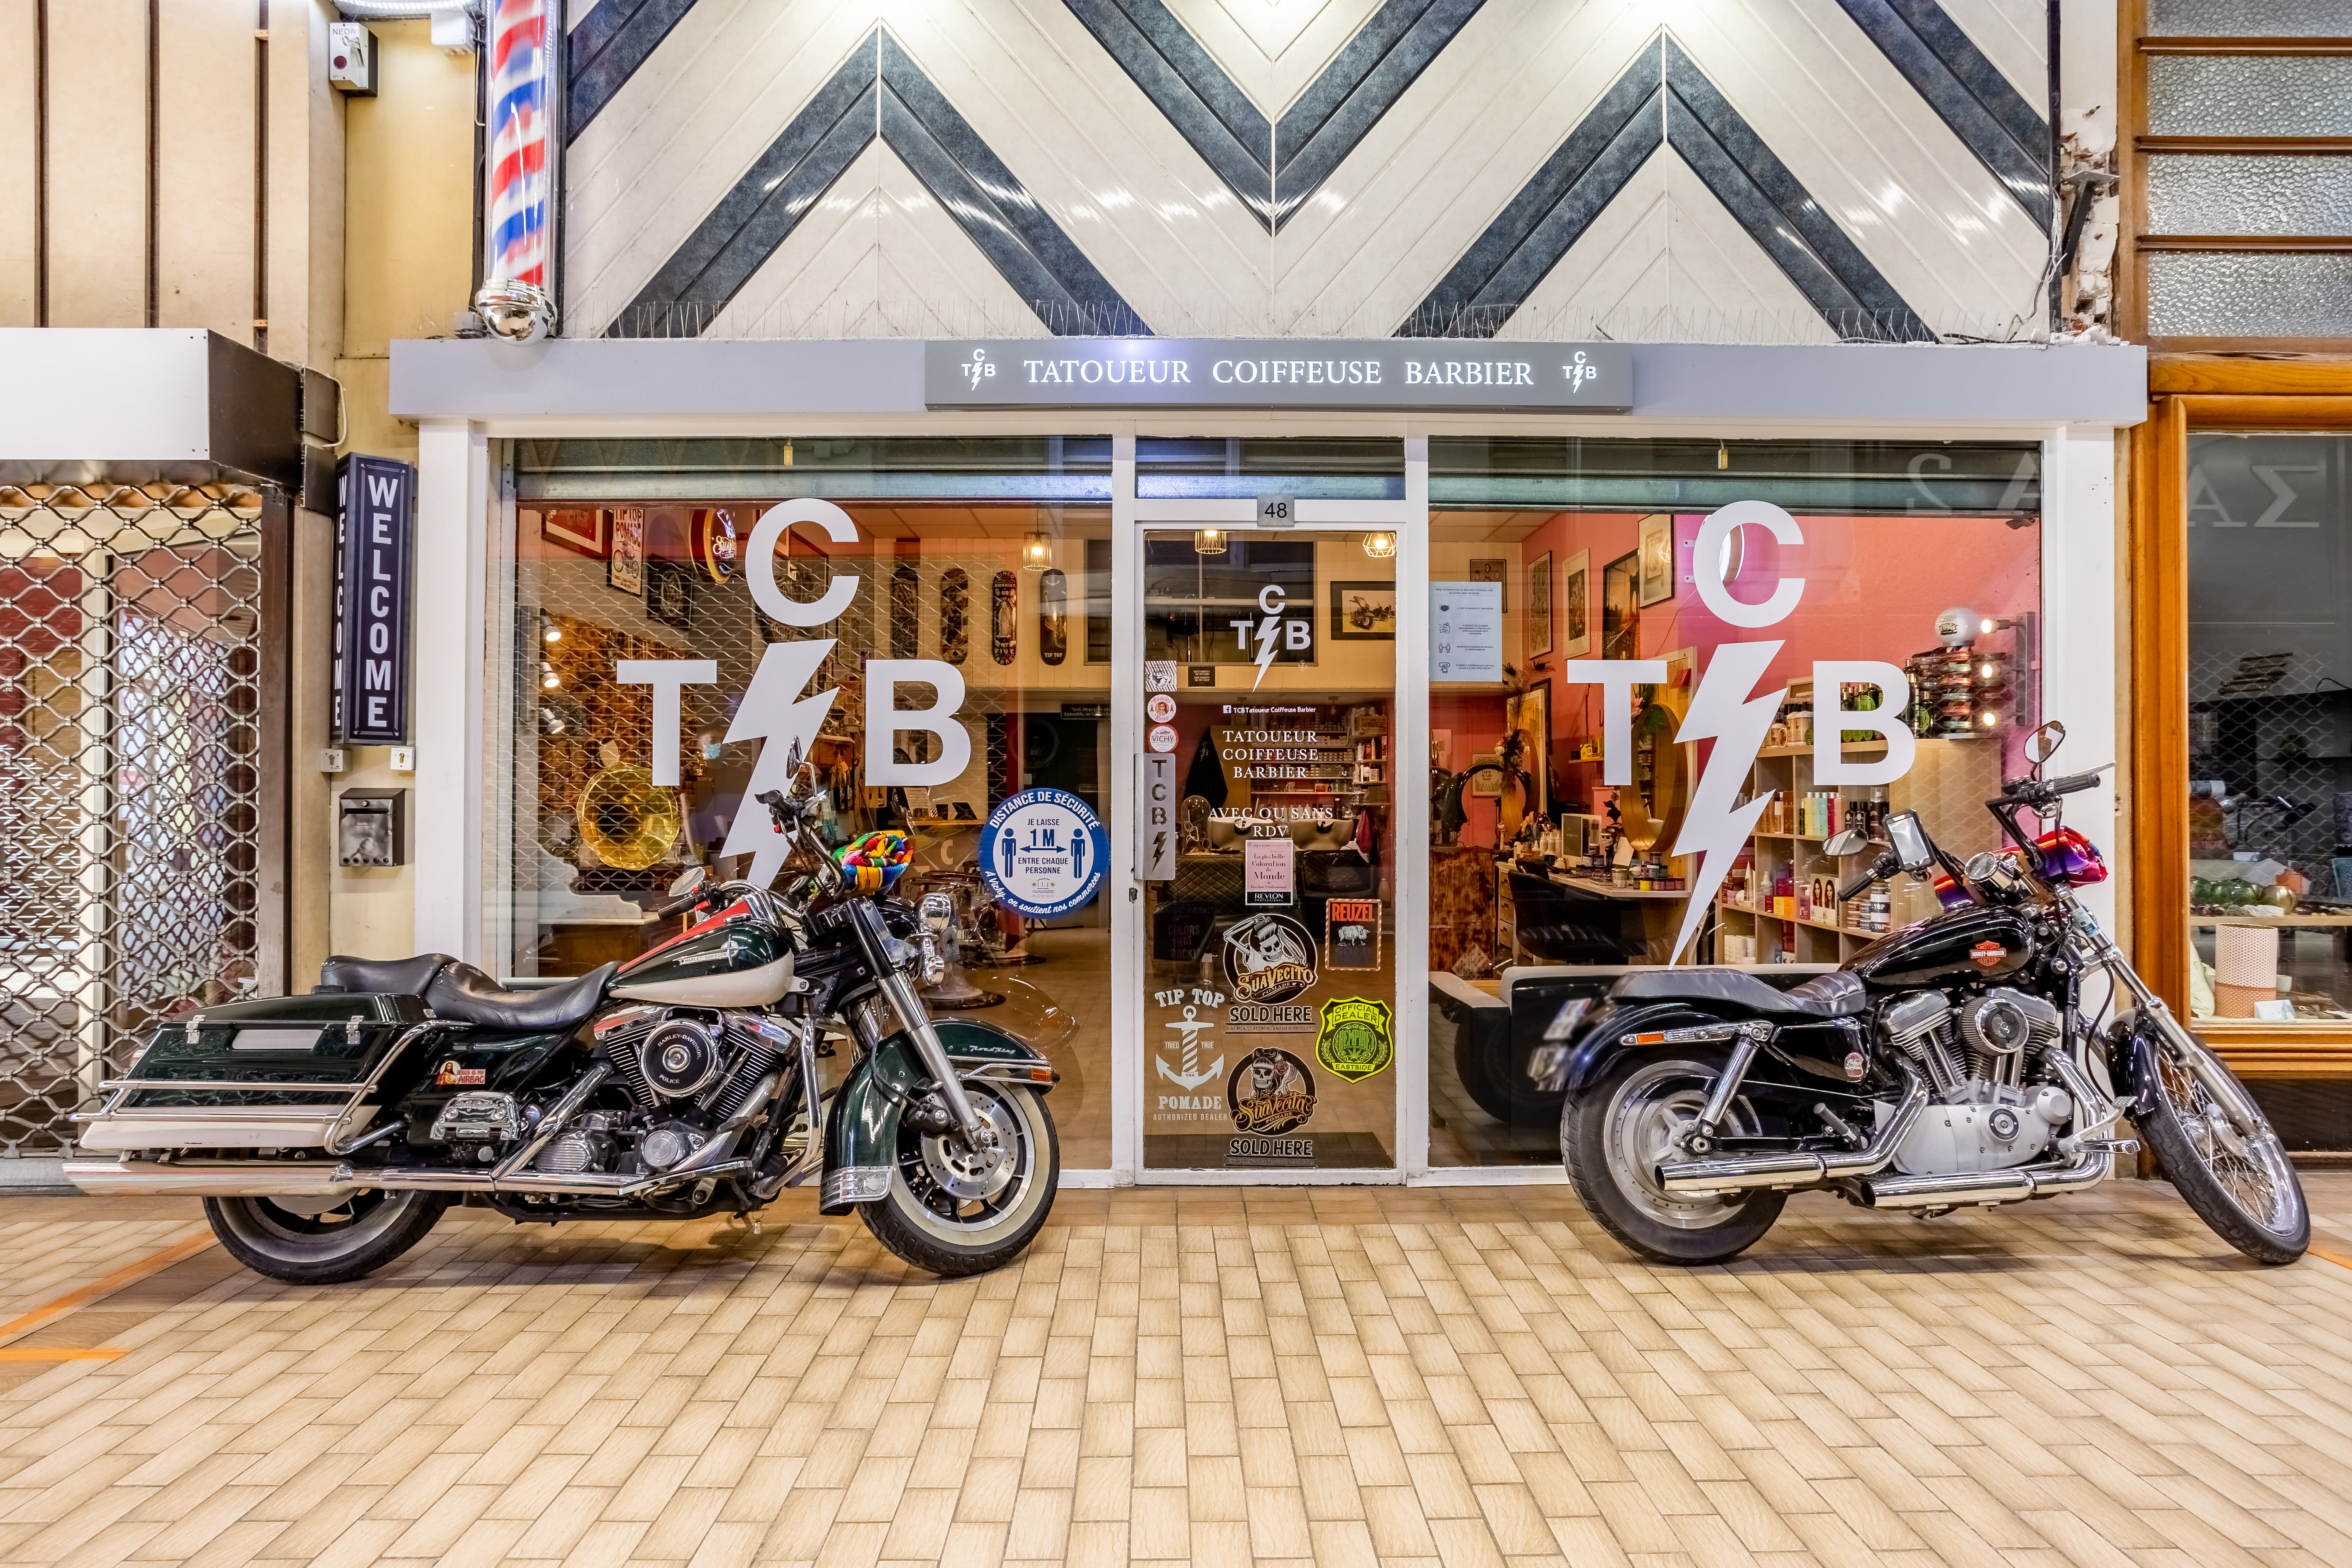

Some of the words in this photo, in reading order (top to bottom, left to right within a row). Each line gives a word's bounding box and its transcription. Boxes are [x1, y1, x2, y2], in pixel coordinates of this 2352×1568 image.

[1024, 360, 1192, 383] TATOUEUR
[1212, 359, 1381, 385] COIFFEUSE
[1405, 361, 1534, 386] BARBIER
[1264, 502, 1287, 518] 48
[335, 474, 347, 726] WELCOME
[365, 475, 398, 727] WELCOME
[995, 655, 1014, 664] BORO
[1155, 713, 1169, 722] Roses
[1223, 731, 1318, 742] TATOUEUR
[1222, 749, 1319, 760] COIFFEUSE
[1233, 767, 1308, 778] BARBIER
[990, 792, 1035, 829] DISTANCE
[1038, 791, 1052, 802] DE
[1054, 792, 1100, 830] SÉCURITÉ
[1208, 807, 1253, 819] AVEC
[1259, 807, 1285, 819] OU
[1291, 807, 1333, 819] SANS
[1030, 829, 1037, 846] 1
[1042, 829, 1055, 846] M
[1253, 825, 1289, 837] RDV
[1254, 871, 1285, 880] Monde
[989, 876, 1006, 900] Vichy,
[1008, 898, 1018, 907] on
[1019, 903, 1052, 914] soutient
[1053, 905, 1067, 913] nos
[1068, 871, 1101, 908] commerces
[1332, 903, 1375, 922] REUZEL
[685, 953, 726, 962] HARLEY-DAVIDSON
[1262, 982, 1291, 996] POMADE
[1154, 989, 1184, 1008] TIP
[1192, 988, 1225, 1008] TOP
[1230, 1006, 1270, 1022] SOLD
[1273, 1006, 1312, 1022] HERE
[1334, 1011, 1378, 1023] DEALER
[1335, 1004, 1377, 1016] OFFICIAL
[657, 1034, 702, 1060] HARLEY-DAVIDSON
[1339, 1030, 1371, 1051] HEMPIRE
[658, 1074, 680, 1084] POLICE
[1158, 1096, 1222, 1110] POMADE
[1266, 1112, 1293, 1124] POMADE
[1230, 1138, 1271, 1155] SOLD
[1273, 1139, 1312, 1156] HERE
